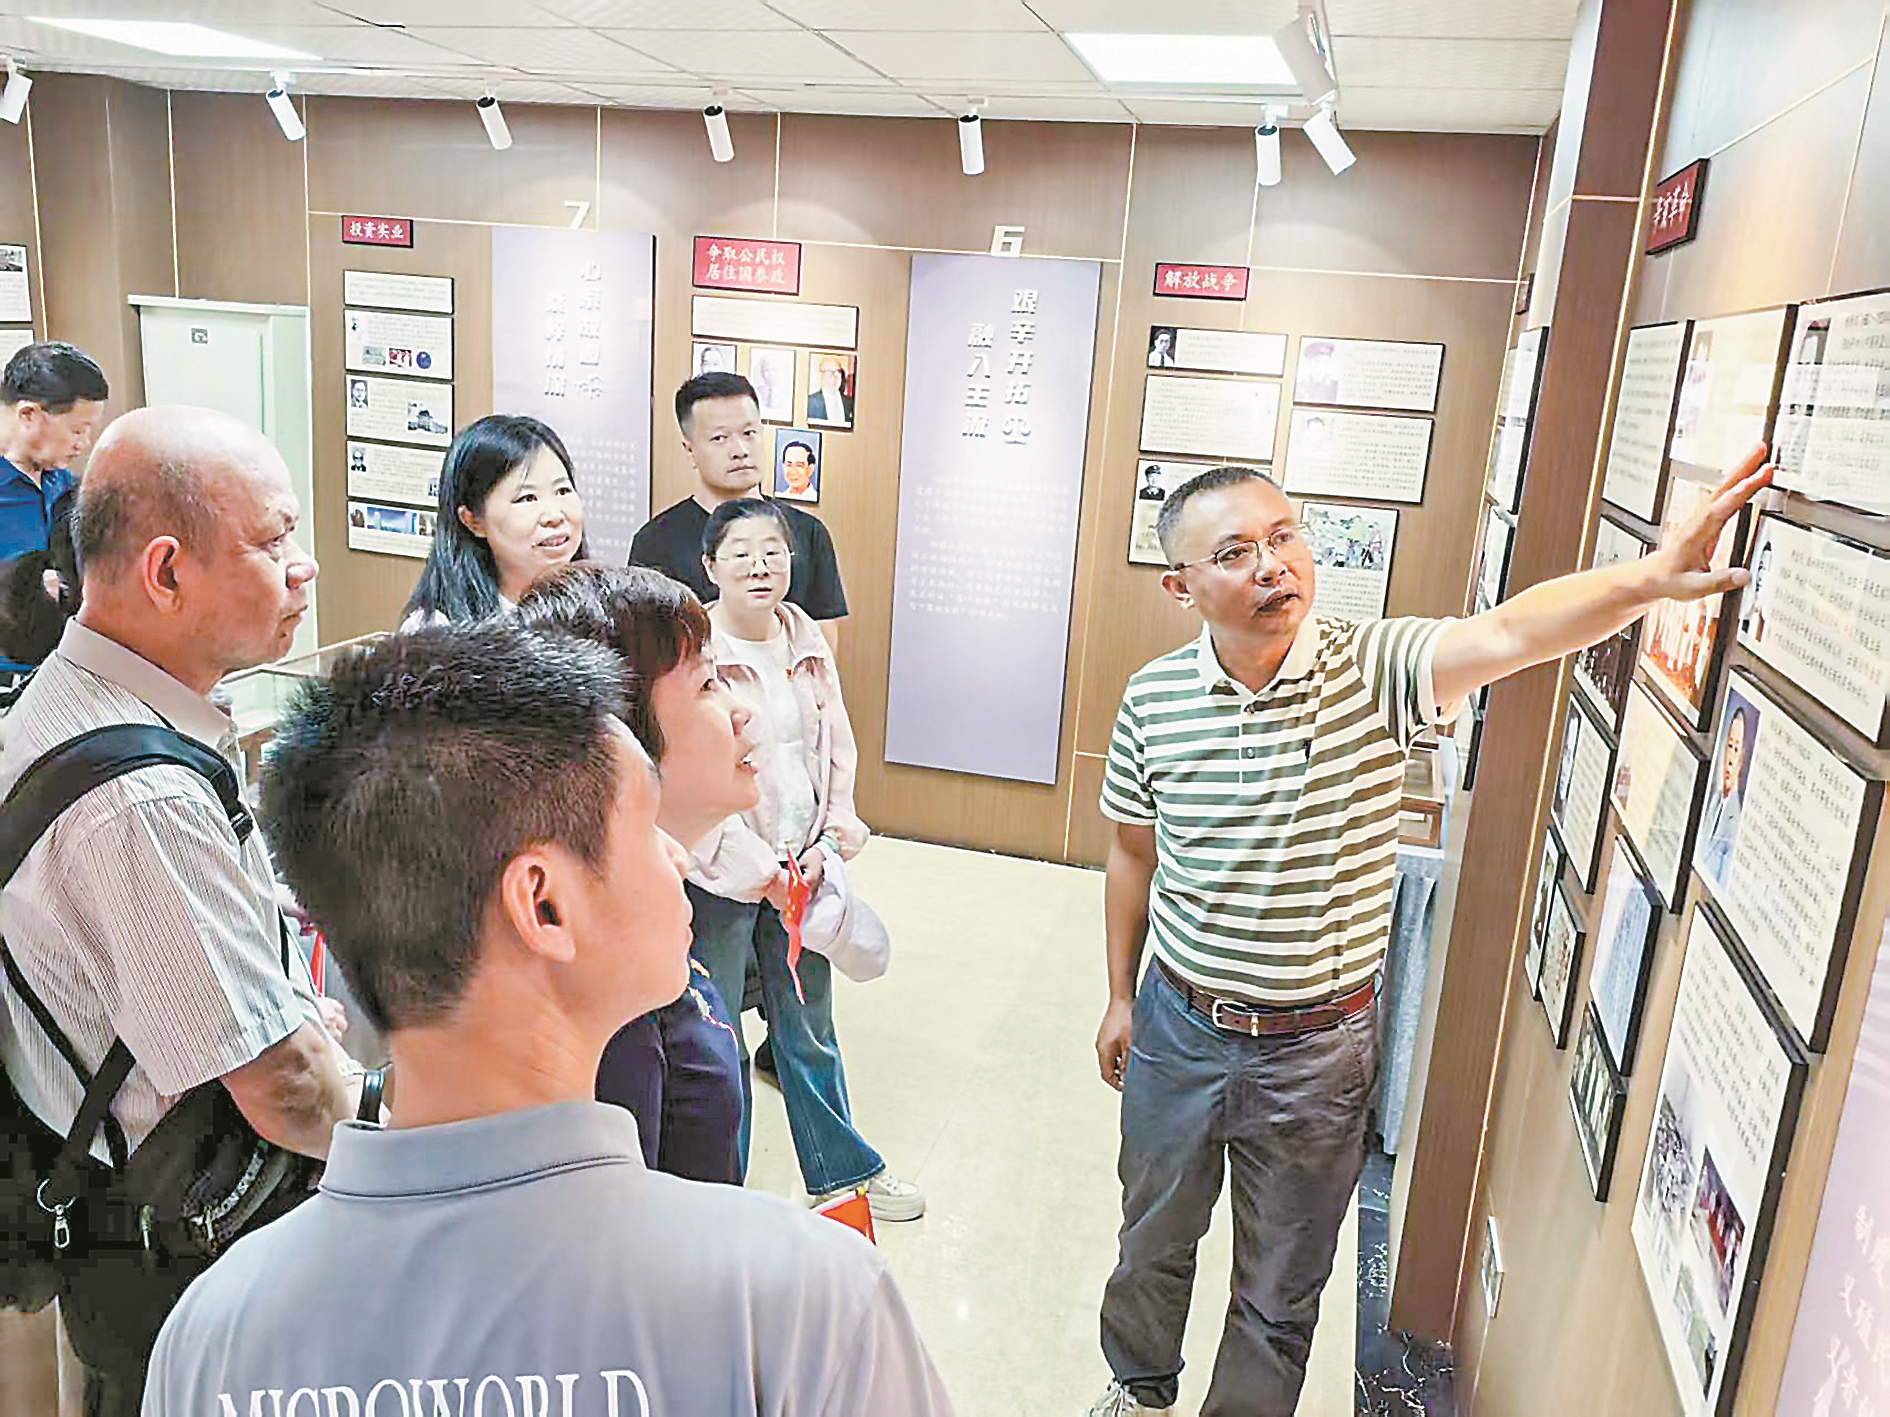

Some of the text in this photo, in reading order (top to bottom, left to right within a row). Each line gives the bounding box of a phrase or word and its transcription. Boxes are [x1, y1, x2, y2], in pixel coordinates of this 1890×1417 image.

[564, 200, 590, 230] 7
[708, 243, 785, 265] 争取公民权
[991, 226, 1025, 257] 6
[1164, 270, 1237, 291] 解放战争
